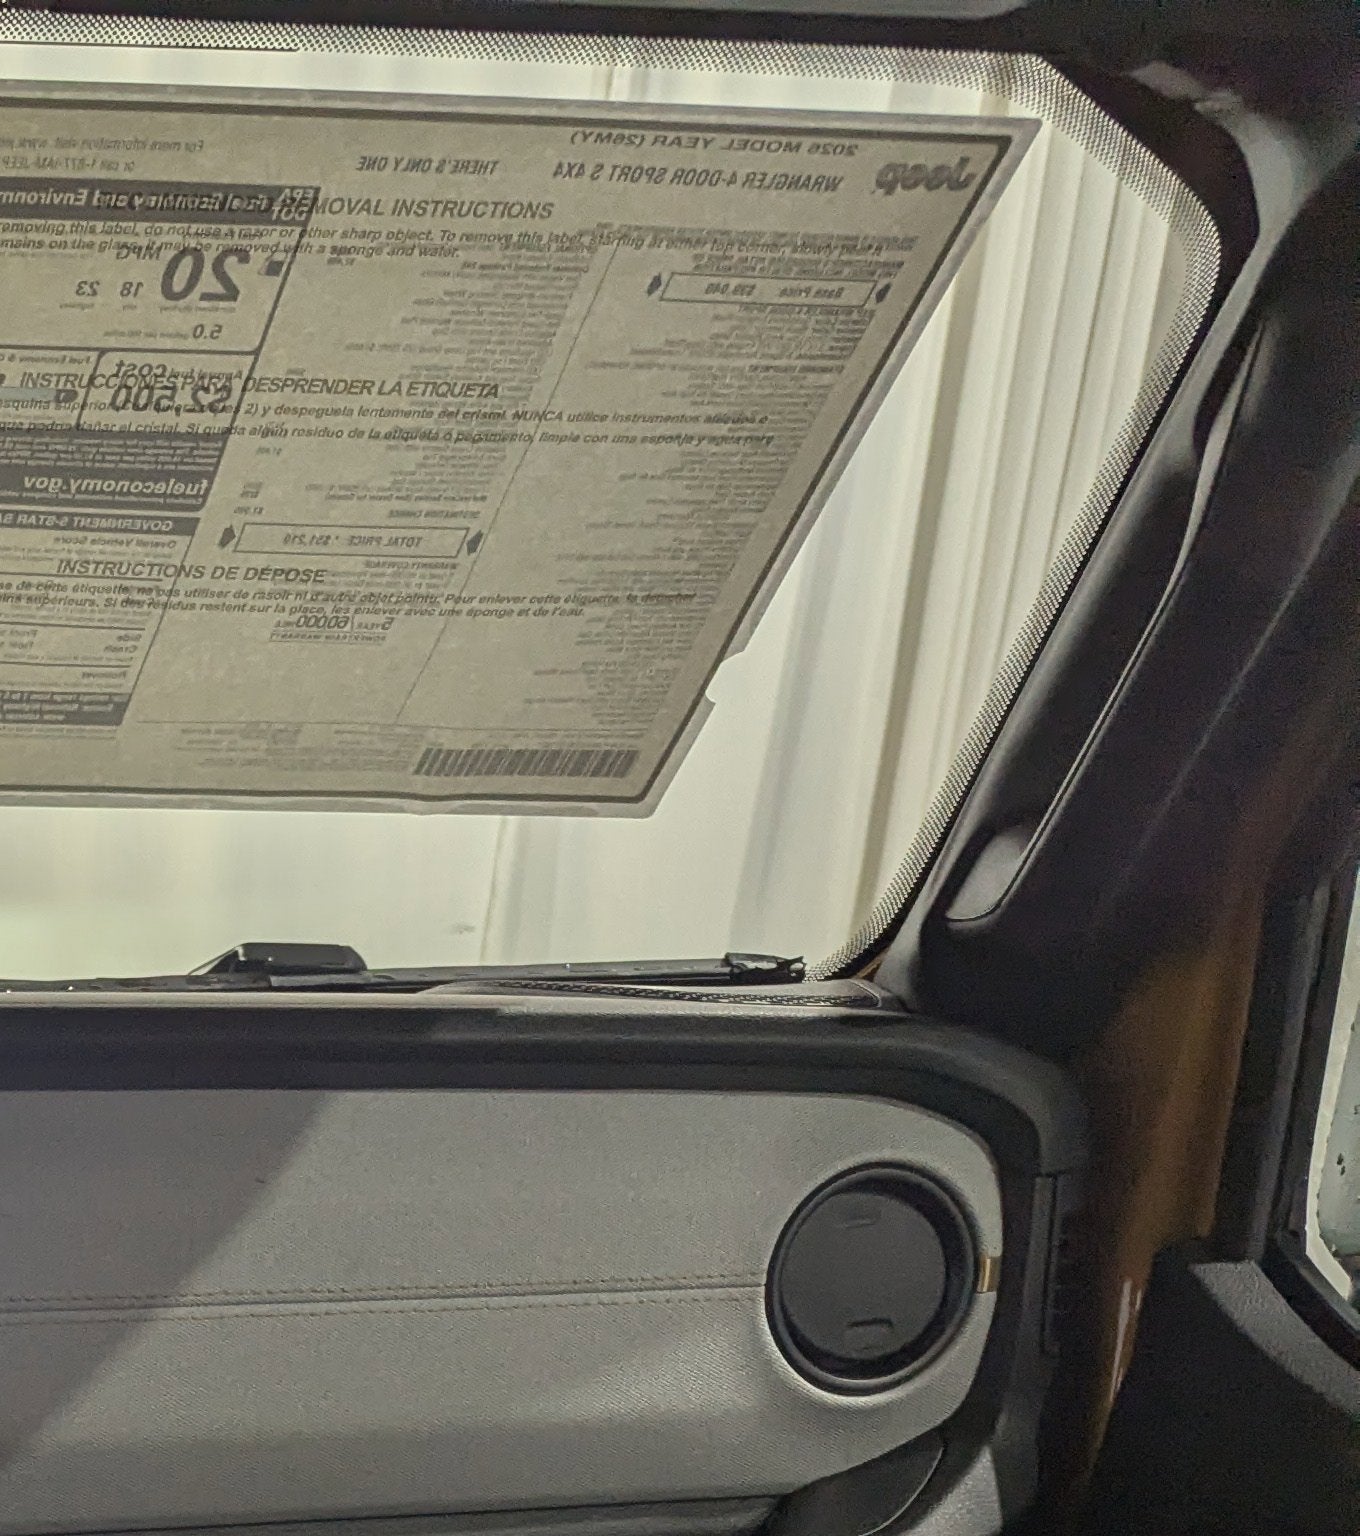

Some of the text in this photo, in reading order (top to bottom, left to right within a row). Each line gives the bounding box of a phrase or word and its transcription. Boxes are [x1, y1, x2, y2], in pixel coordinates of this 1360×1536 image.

[390, 200, 555, 221] INSTRUCTIONS
[68, 221, 97, 235] this
[340, 228, 382, 243] sharp
[242, 375, 500, 398] DESPRENDER LA ETIQUETA
[56, 560, 204, 580] INSTRUCTIONS
[210, 565, 238, 581] DE
